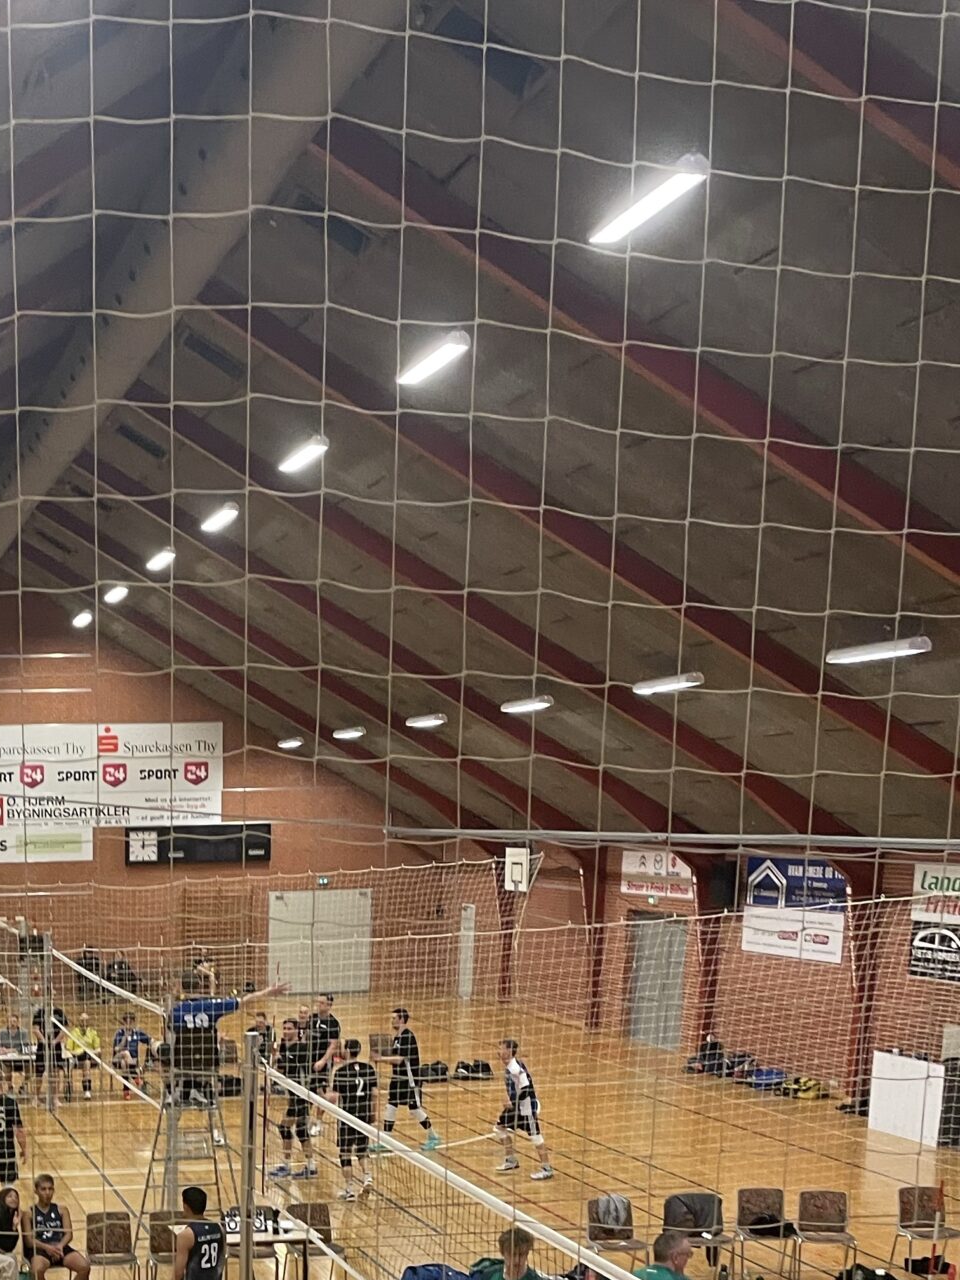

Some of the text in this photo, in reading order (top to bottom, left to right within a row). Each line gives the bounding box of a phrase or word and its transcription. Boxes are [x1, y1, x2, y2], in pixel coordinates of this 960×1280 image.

[63, 741, 86, 755] Thy
[123, 739, 218, 756] Sparekassen Thy
[58, 766, 125, 782] SPORT 24
[140, 765, 206, 780] SPORT 24
[7, 806, 130, 819] BYGNINGSARTIKLER
[355, 1079, 365, 1096] 2
[201, 1242, 219, 1269] 28
